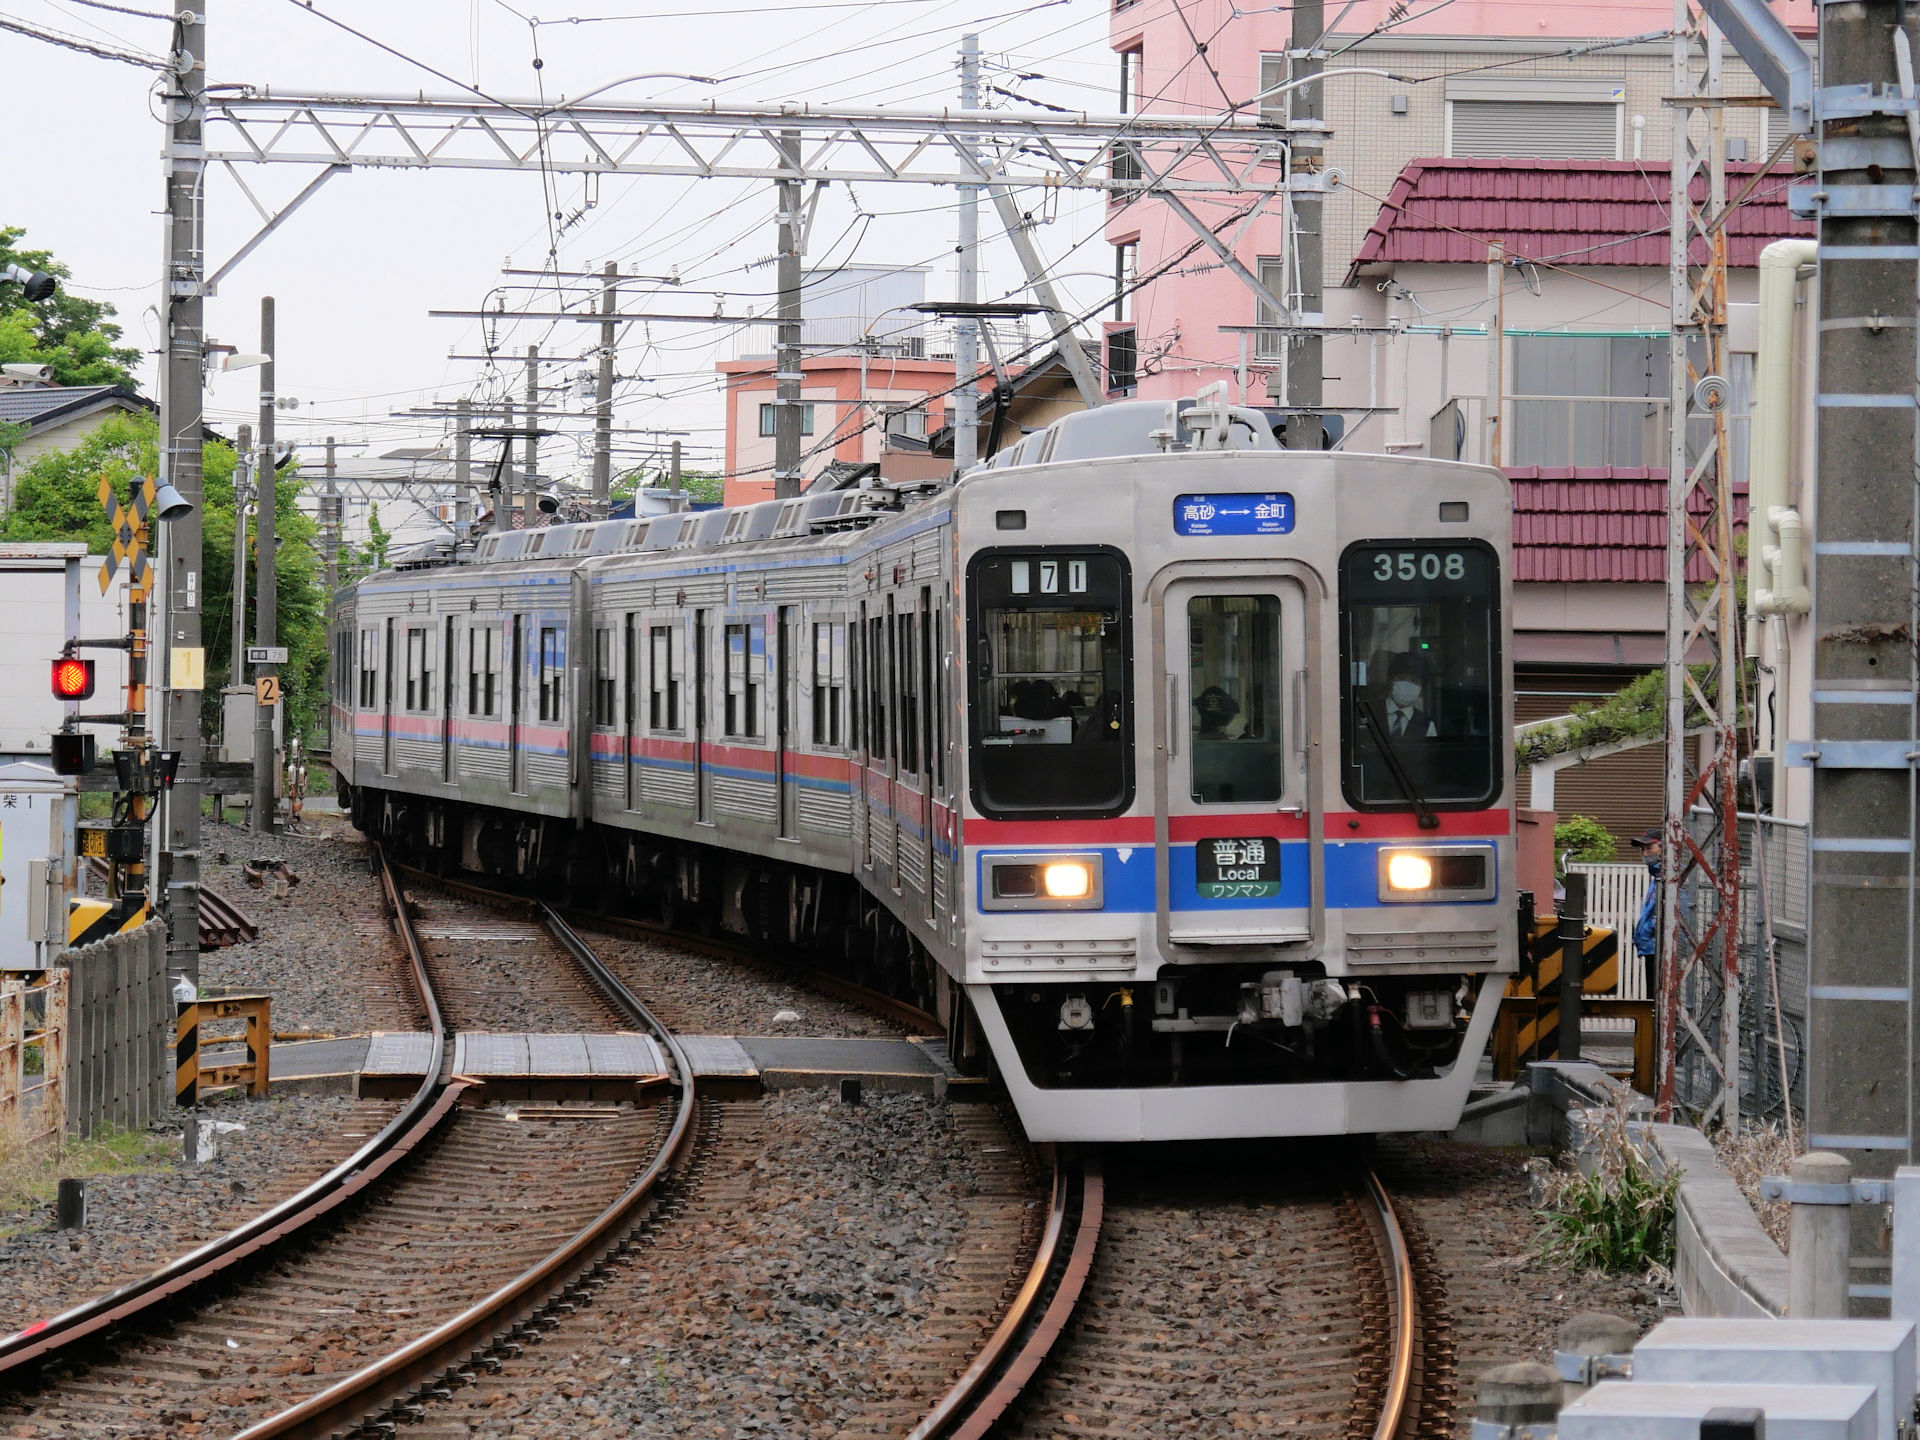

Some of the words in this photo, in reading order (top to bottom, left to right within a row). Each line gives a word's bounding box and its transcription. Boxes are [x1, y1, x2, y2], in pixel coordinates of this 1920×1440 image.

[1183, 503, 1216, 521] 高砂
[1254, 503, 1287, 519] 金町
[1373, 553, 1465, 581] 3508
[182, 651, 191, 678] 1
[262, 679, 274, 700] 2
[3, 794, 17, 809] 柴
[27, 795, 32, 809] 1
[1212, 839, 1267, 866] 普通
[1218, 867, 1260, 881] Local
[1212, 884, 1269, 898] ワンマン
